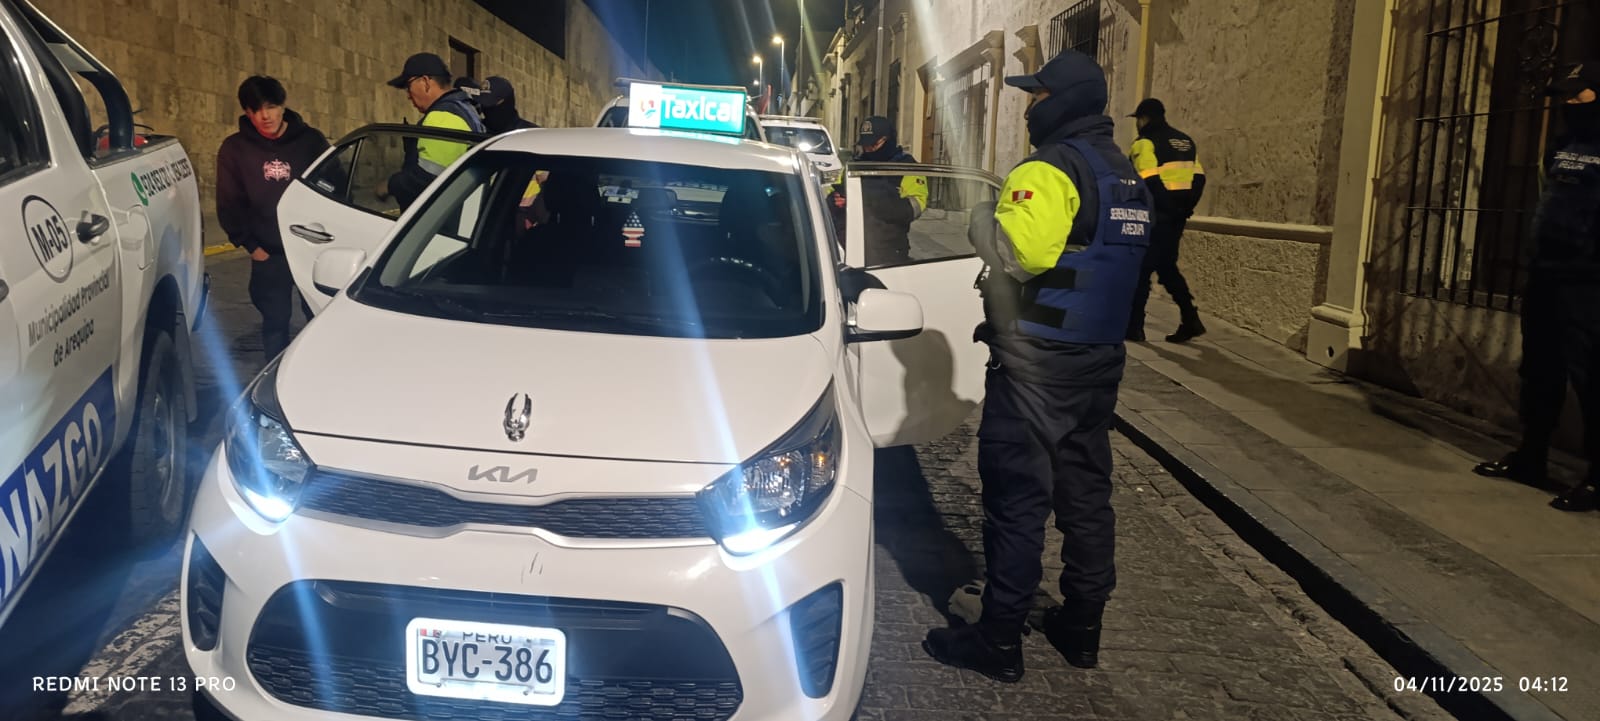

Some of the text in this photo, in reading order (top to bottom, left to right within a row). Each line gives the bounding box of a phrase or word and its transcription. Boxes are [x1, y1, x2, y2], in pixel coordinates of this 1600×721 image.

[31, 215, 68, 262] M-05
[28, 268, 110, 347] Municipalidad Provincial
[53, 318, 94, 367] de Arequipa
[422, 638, 553, 684] BYC-386
